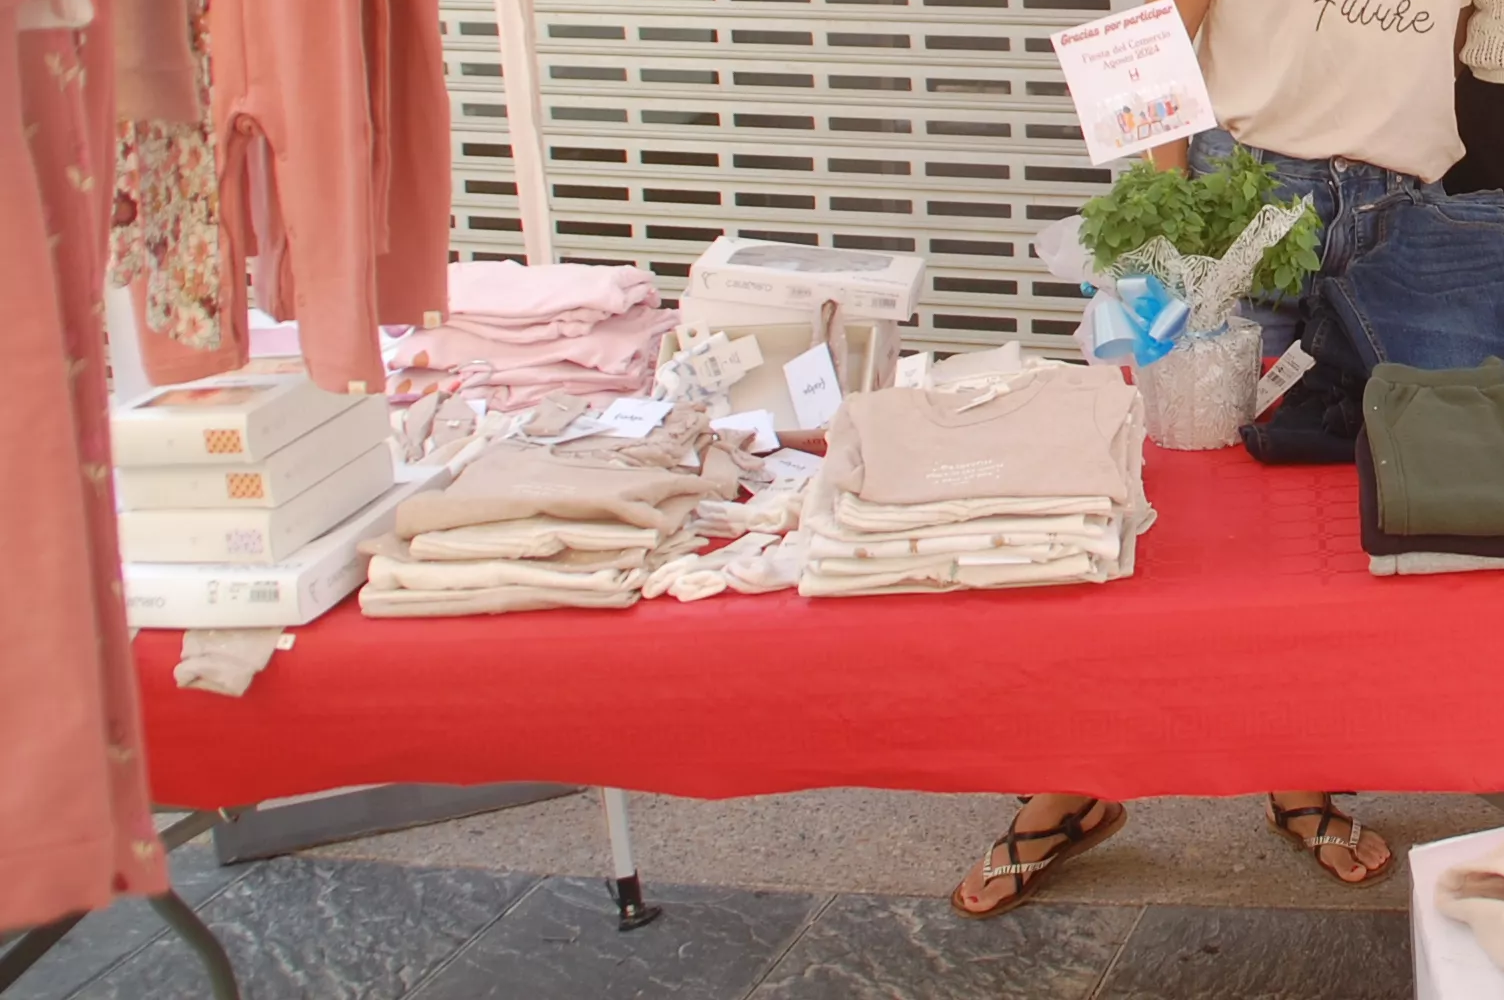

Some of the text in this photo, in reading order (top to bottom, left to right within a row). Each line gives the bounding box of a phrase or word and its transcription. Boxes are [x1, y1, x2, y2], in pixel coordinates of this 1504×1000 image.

[1060, 5, 1174, 46] Gracias por participar
[1081, 30, 1171, 64] Fiesta del Comercio
[1135, 44, 1161, 60] 2024
